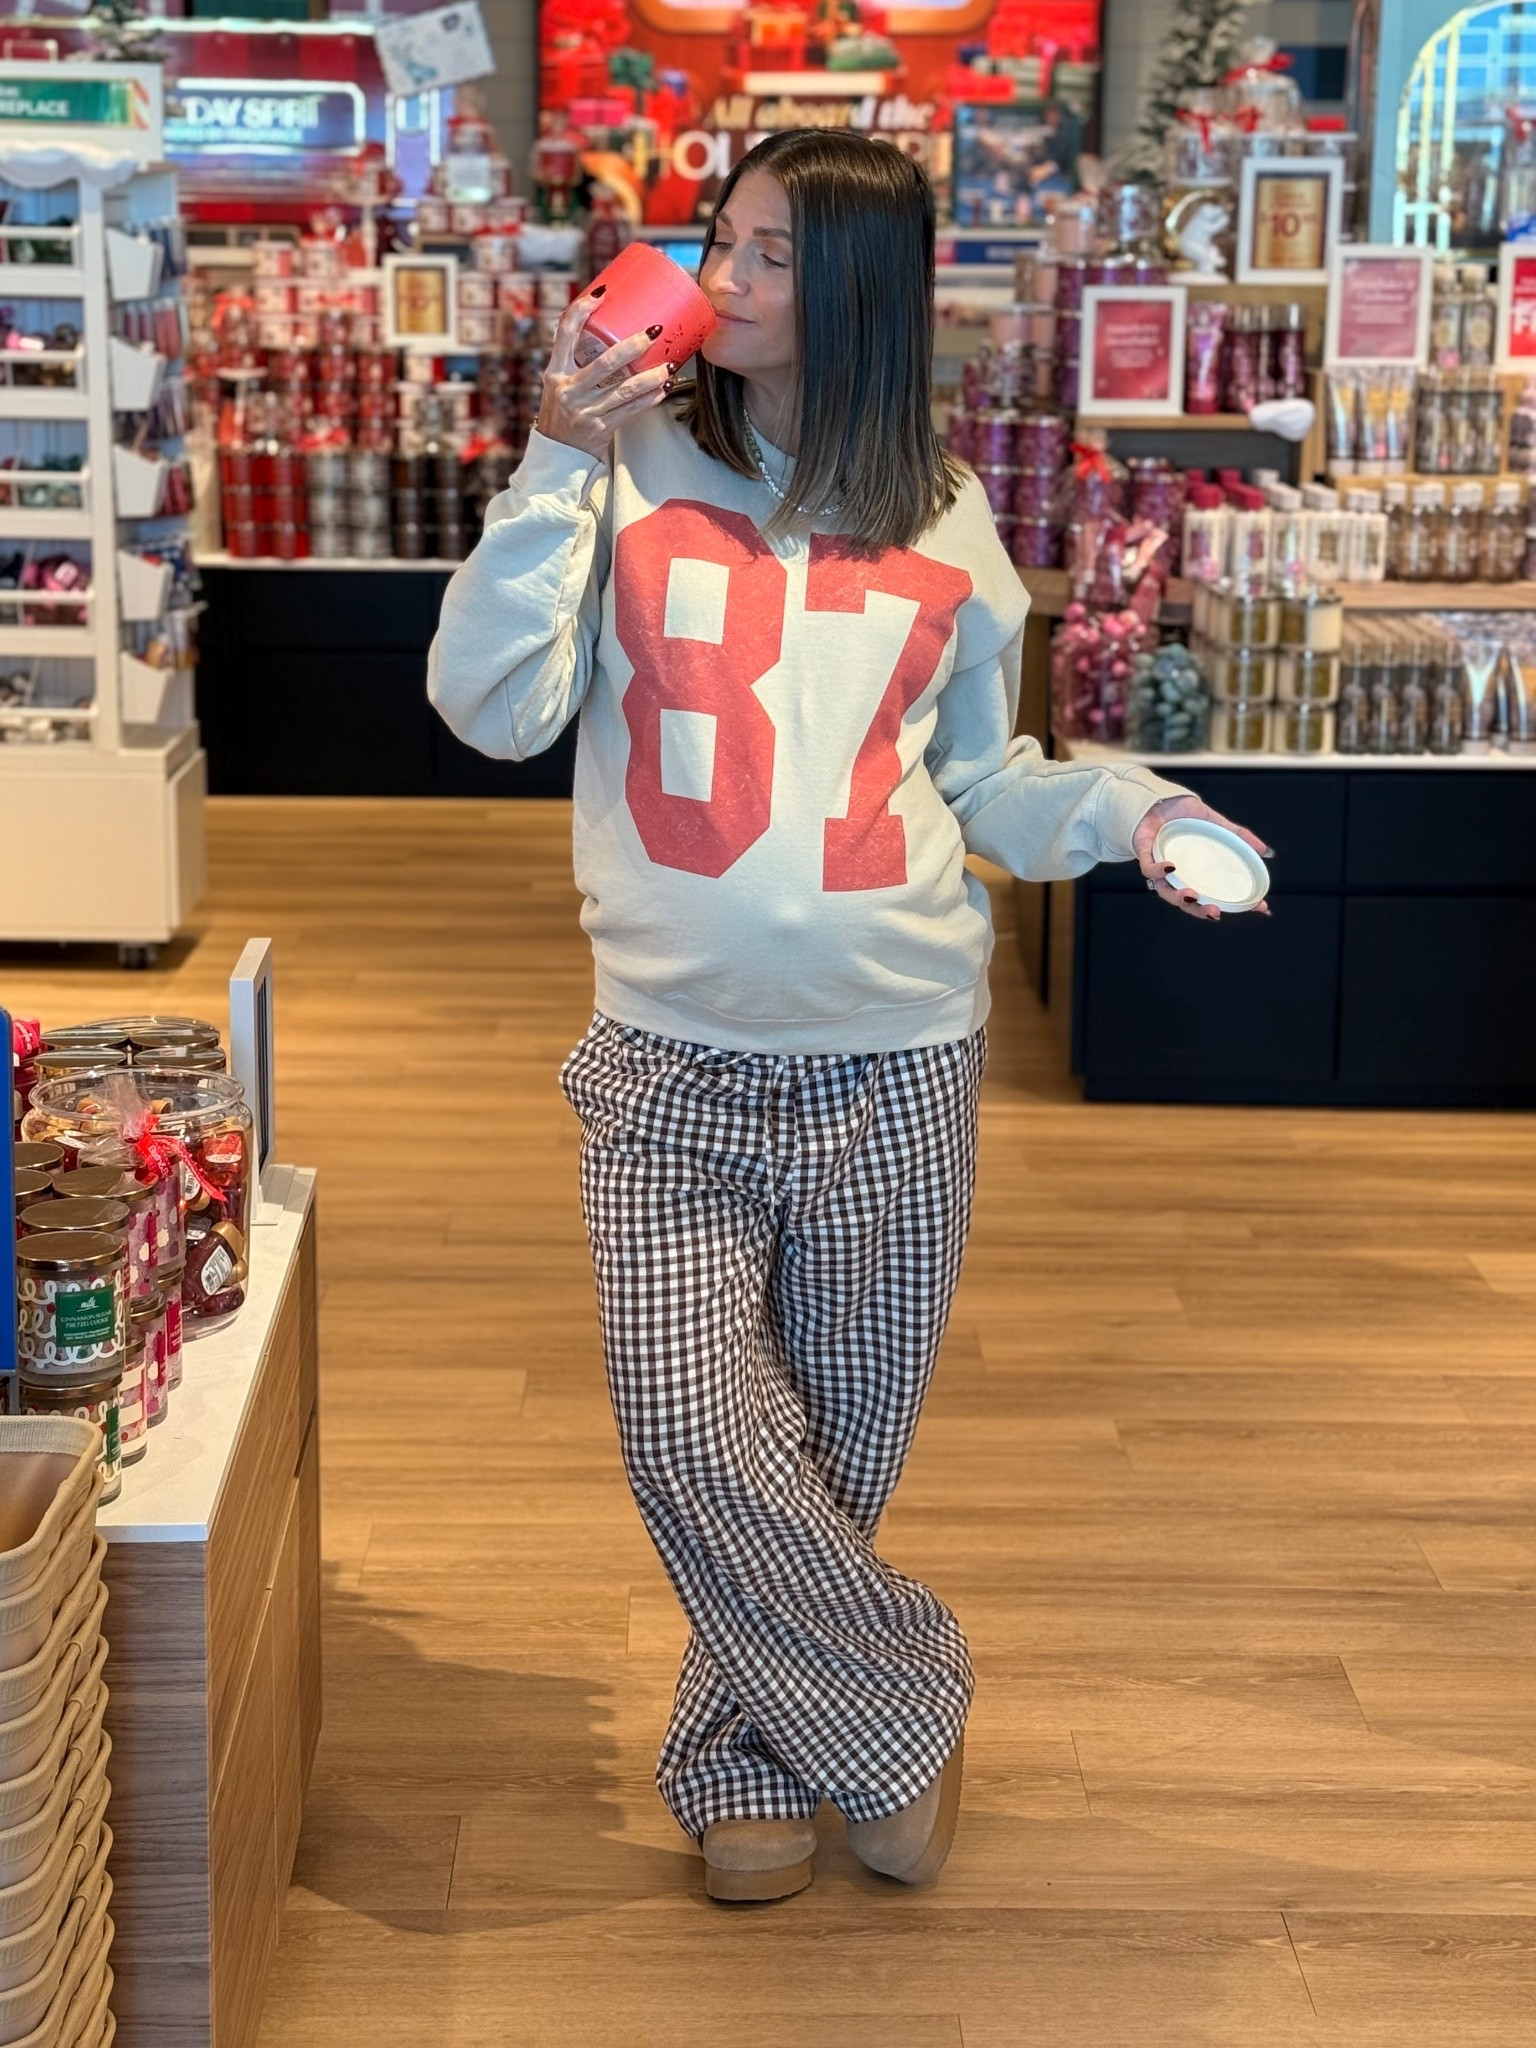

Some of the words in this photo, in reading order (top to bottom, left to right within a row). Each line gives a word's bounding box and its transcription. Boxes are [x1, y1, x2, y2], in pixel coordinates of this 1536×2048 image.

[878, 94, 935, 129] the
[614, 498, 974, 892] 87
[61, 1315, 96, 1323] CINNAMON
